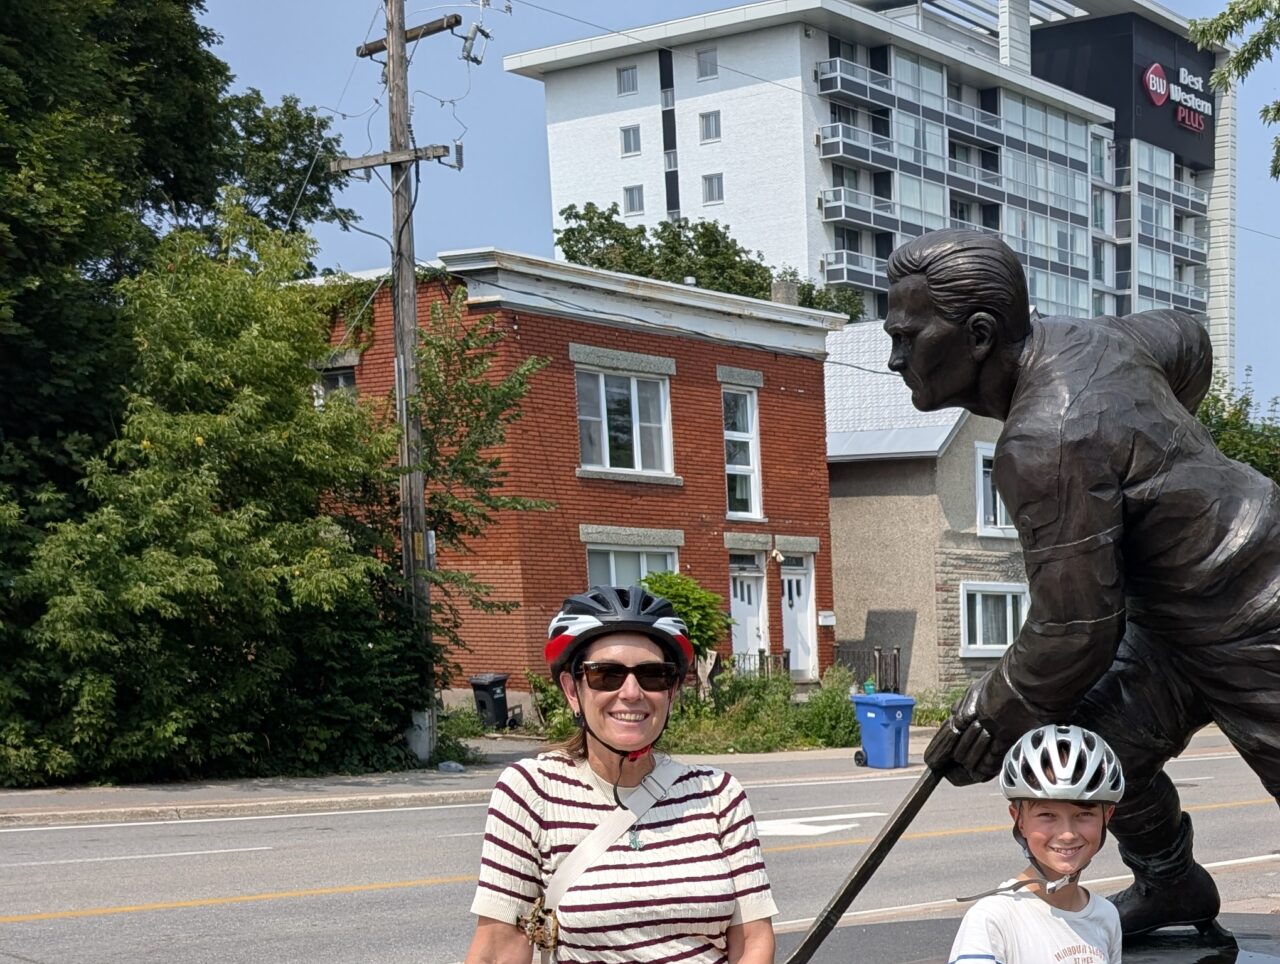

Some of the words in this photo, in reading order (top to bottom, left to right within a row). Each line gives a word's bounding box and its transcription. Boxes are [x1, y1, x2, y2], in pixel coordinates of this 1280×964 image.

[1149, 74, 1167, 95] BW
[1179, 67, 1204, 92] Best
[1169, 83, 1212, 116] Western
[1177, 106, 1205, 130] PLUS
